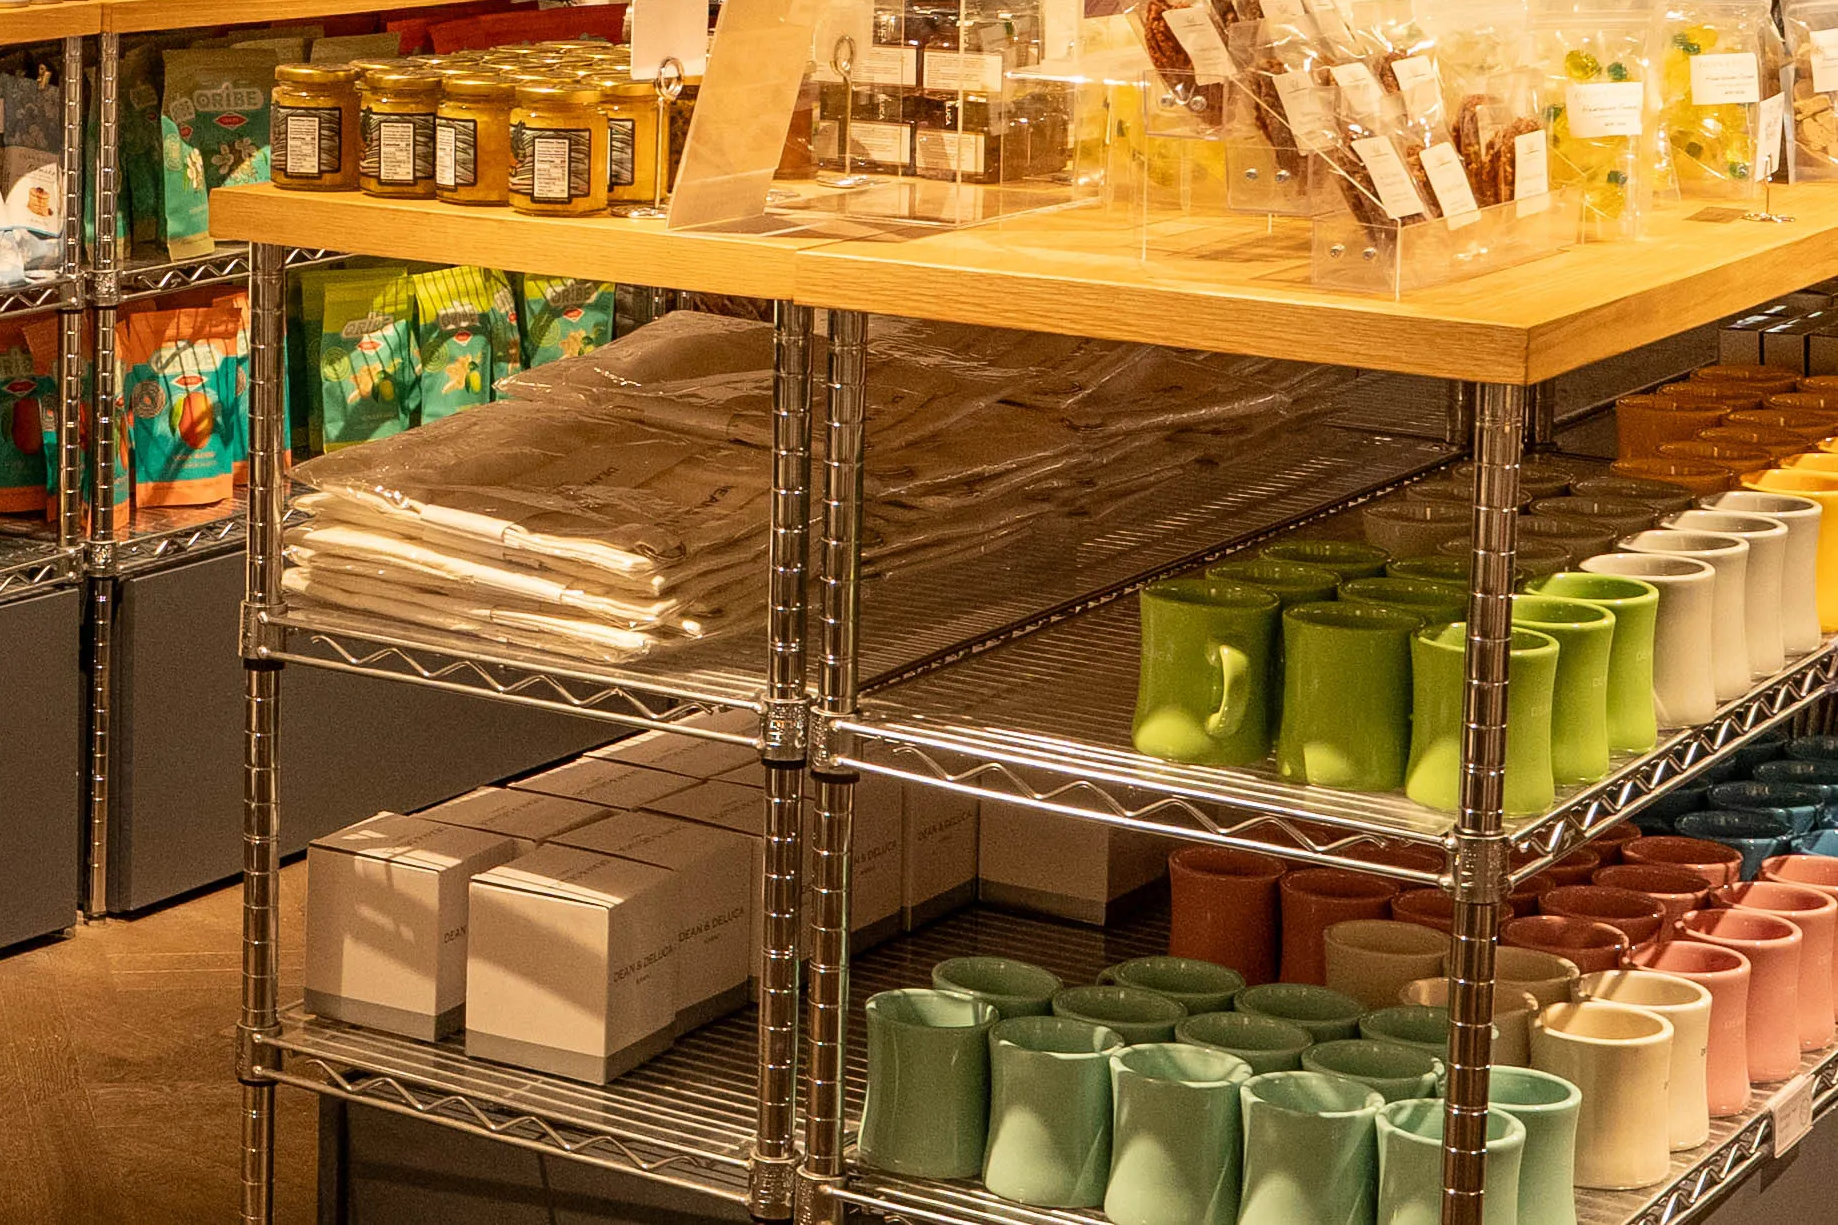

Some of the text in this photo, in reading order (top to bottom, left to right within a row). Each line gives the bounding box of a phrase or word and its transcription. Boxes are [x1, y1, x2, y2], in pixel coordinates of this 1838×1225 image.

[677, 924, 703, 943] DEAN
[712, 906, 745, 931] DELUCA
[613, 962, 636, 983] DEAN
[642, 944, 674, 970] DELUCA
